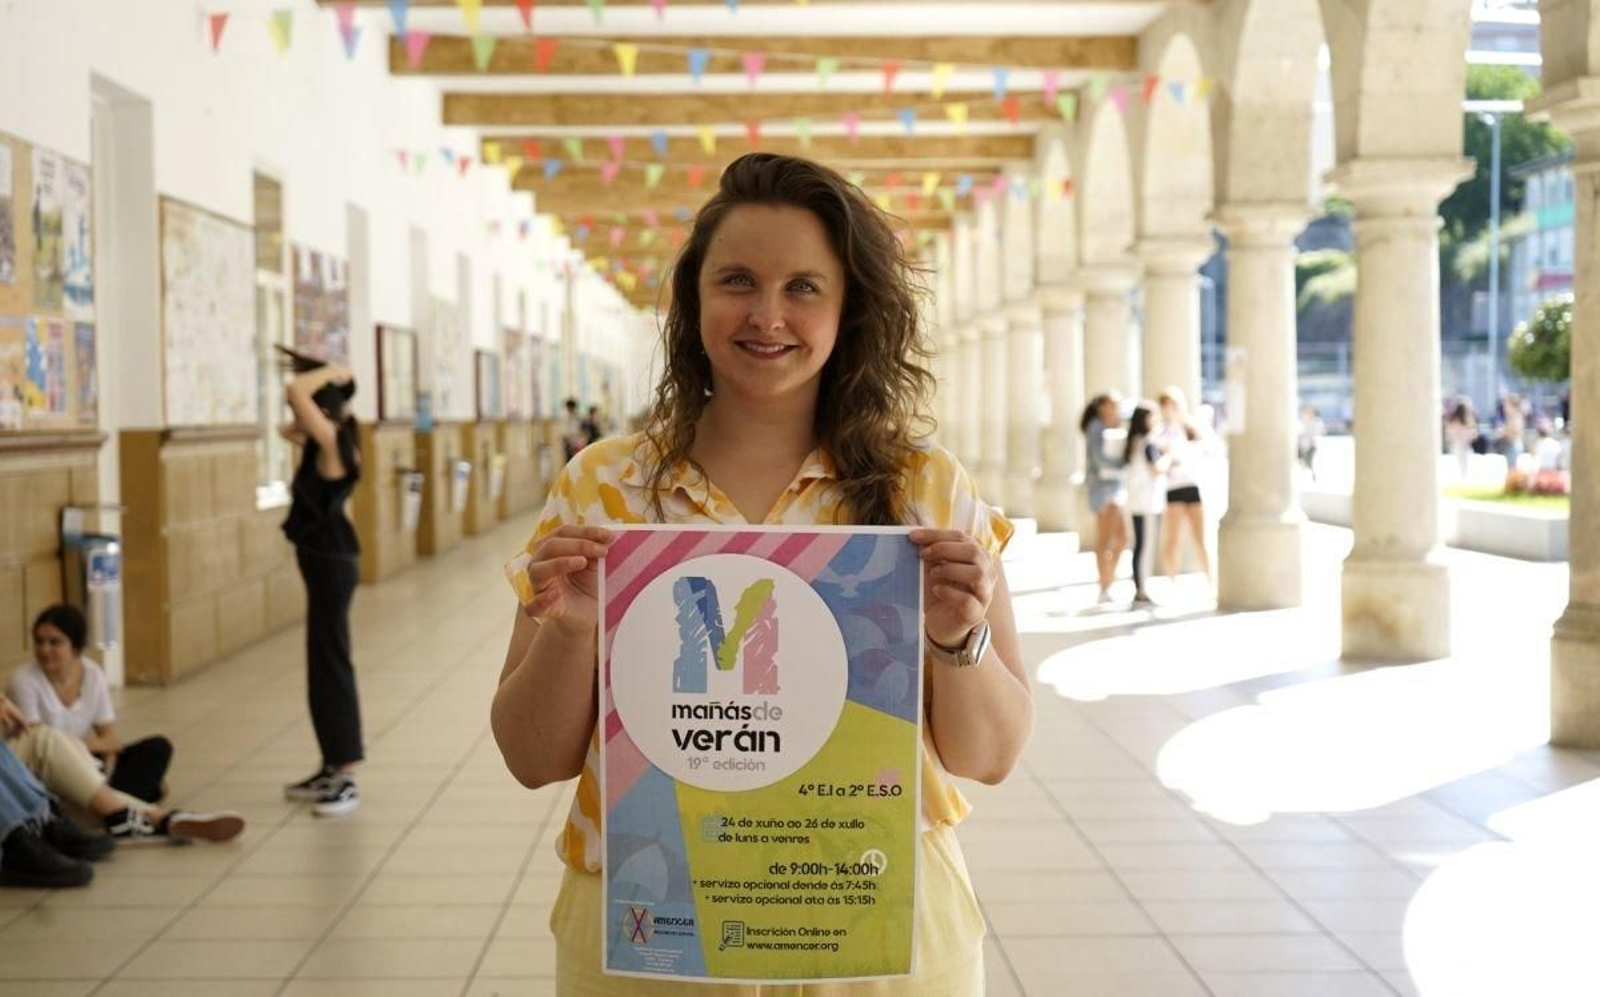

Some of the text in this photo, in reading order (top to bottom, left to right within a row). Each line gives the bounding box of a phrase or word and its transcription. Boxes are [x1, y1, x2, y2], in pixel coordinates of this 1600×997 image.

[671, 723, 781, 753] verán
[712, 758, 766, 771] edición
[799, 784, 815, 796] 4º
[836, 787, 846, 796] a
[849, 785, 864, 796] 2º
[867, 785, 902, 797] E.S.O
[720, 816, 865, 830] 24 de xuño ao 26 de xullo
[718, 833, 733, 842] de
[735, 833, 758, 843] luns
[771, 836, 810, 844] venres
[769, 862, 878, 875] de 9:00h-14:00h
[700, 879, 741, 889] servizo
[743, 880, 790, 892] opcional
[792, 880, 828, 890] dende
[845, 880, 876, 891] 7:45h
[711, 894, 752, 904] servizo
[755, 894, 802, 906] opcional
[805, 895, 823, 905] ata
[842, 895, 876, 905] 15:15h
[746, 927, 846, 937] Inscrición Online en
[746, 941, 839, 952] www.amencer.org
